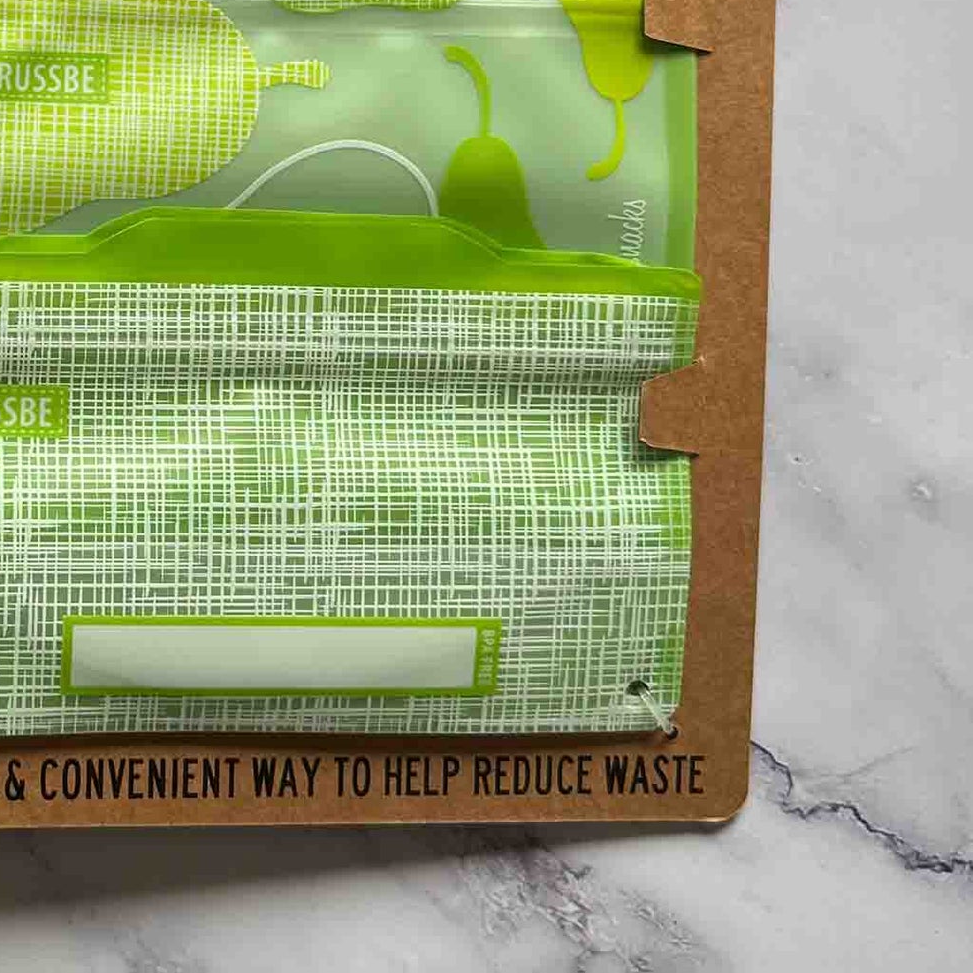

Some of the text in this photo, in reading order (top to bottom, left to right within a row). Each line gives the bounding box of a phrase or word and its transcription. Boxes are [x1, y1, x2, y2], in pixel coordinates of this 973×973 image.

[607, 199, 647, 260] nacks
[4, 758, 26, 802] &
[39, 757, 240, 801] CONVENIENT
[252, 757, 321, 798] WAY
[334, 755, 371, 797] TO
[383, 755, 461, 796] HELP
[473, 754, 593, 796] REDUCE
[604, 754, 705, 795] WASTE
